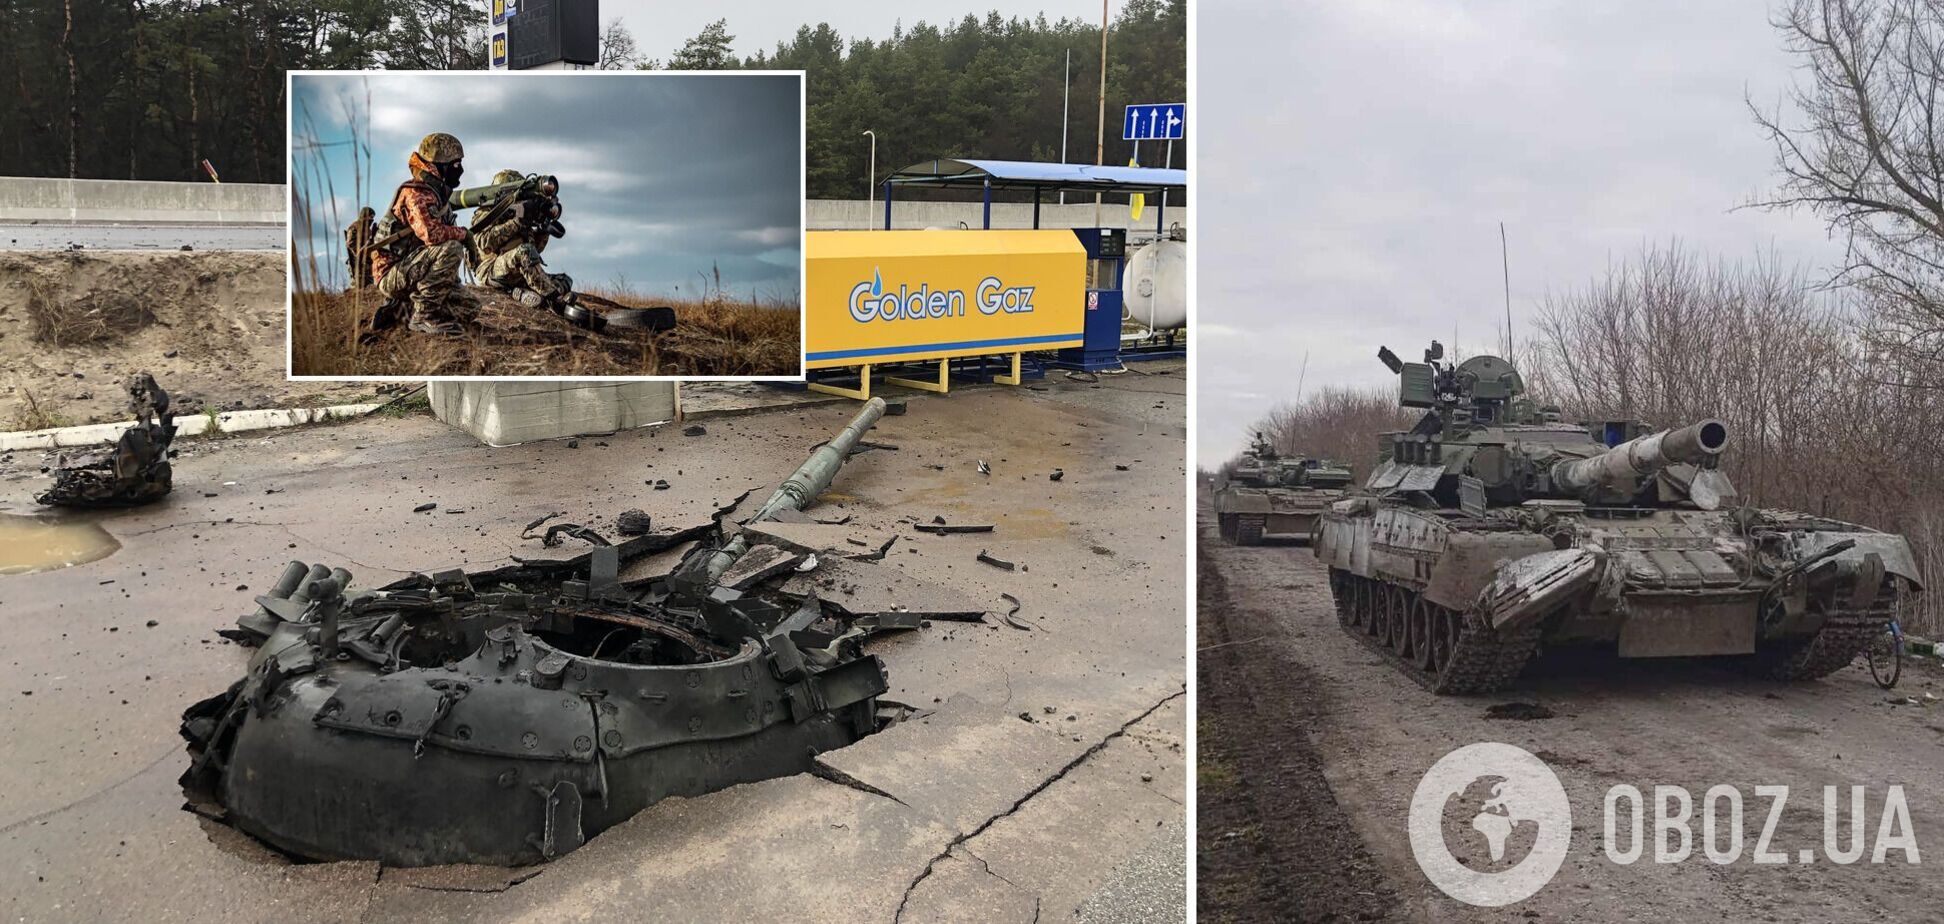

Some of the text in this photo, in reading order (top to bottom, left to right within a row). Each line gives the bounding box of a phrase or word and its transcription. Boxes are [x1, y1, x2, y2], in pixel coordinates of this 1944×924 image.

[494, 39, 504, 59] ГАЗ
[849, 275, 1035, 323] Golden Gaz
